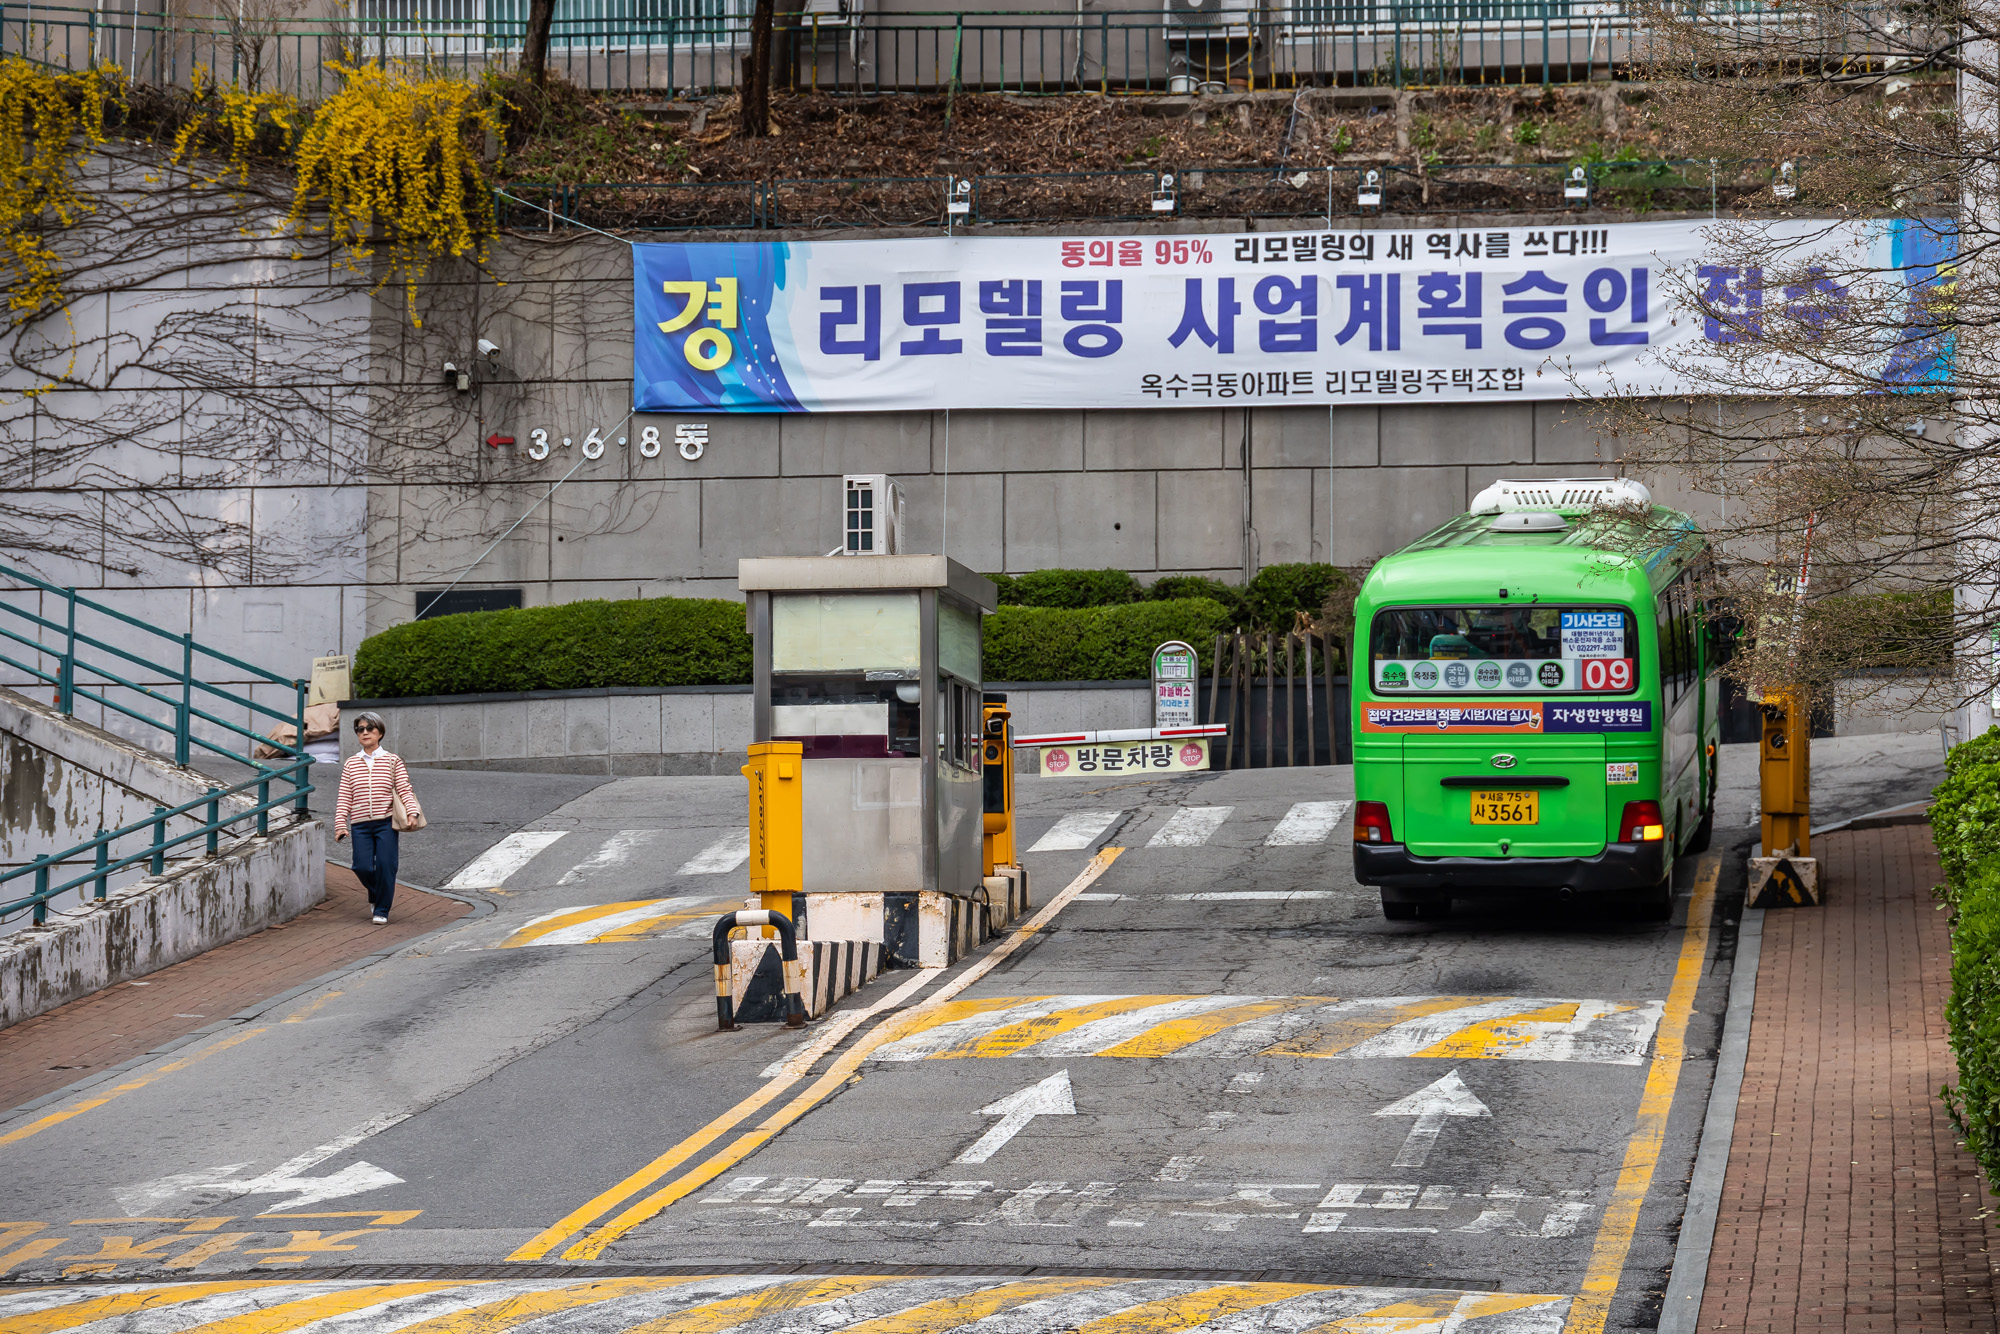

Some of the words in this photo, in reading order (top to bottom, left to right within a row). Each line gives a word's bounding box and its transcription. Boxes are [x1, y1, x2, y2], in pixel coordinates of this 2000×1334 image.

[1061, 239, 1142, 267] 동의율
[1155, 239, 1213, 265] 95%
[1233, 232, 1369, 263] 리모델링의
[1386, 232, 1413, 261] 새
[1427, 231, 1509, 260] 역사를
[1523, 229, 1608, 258] 쓰다!!!
[819, 279, 1123, 361] 리모델링
[1167, 267, 1649, 355] 사업계획승인
[657, 276, 738, 371] 경
[1141, 370, 1314, 398] 옥수극동아파트
[1325, 367, 1525, 394] 리모델링주택조합
[1564, 614, 1622, 628] 기사모집
[1382, 672, 1406, 680] 옥수역
[1414, 672, 1437, 680] 옥정중
[1448, 666, 1465, 675] 국민
[1585, 660, 1630, 689] 09
[1448, 676, 1465, 686] 은행
[1159, 686, 1190, 697] 마을버스
[1369, 709, 1391, 722] 첩약
[1392, 709, 1436, 721] 건강보험
[1438, 709, 1461, 720] 적용
[1462, 709, 1507, 721] 시범사업
[1509, 709, 1532, 721] 실시
[1552, 708, 1642, 722] 자생한방병원
[1077, 744, 1173, 772] 방문차량
[1488, 793, 1503, 802] 서울
[1507, 793, 1522, 801] 75
